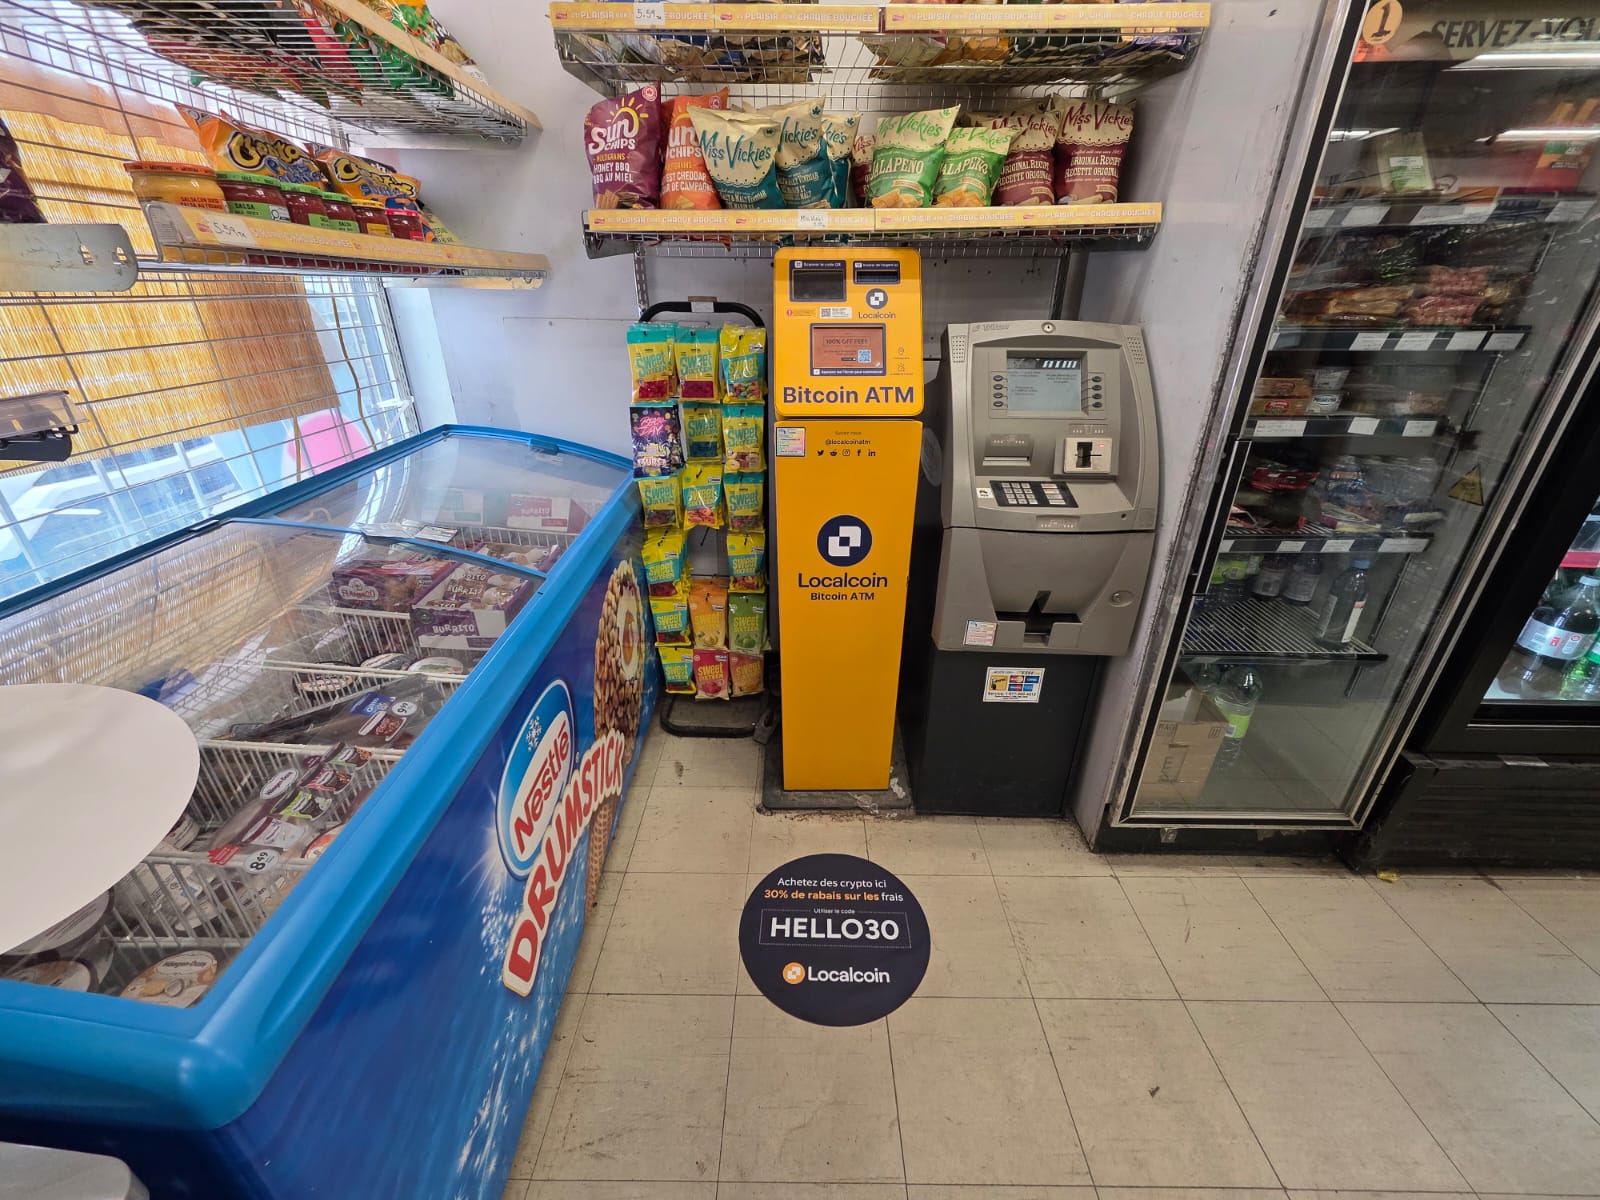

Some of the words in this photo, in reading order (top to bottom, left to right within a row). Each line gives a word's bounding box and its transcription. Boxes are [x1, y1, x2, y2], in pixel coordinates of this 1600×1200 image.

[1371, 3, 1391, 37] 1
[1062, 102, 1092, 137] Miss
[604, 138, 636, 151] CHIPS
[700, 130, 725, 168] Miss
[725, 135, 772, 169] Vickie's
[670, 147, 702, 159] CHIPS
[594, 163, 614, 172] HONEY
[615, 162, 630, 172] BBQ
[614, 173, 634, 183] MIEL
[783, 386, 859, 404] Bitcoin
[865, 386, 914, 403] ATM
[797, 572, 888, 588] Localcoin
[810, 591, 848, 601] Bitcoin
[850, 592, 875, 601] ATM
[432, 624, 475, 634] BURRITO
[514, 720, 570, 855] Nestlé
[507, 734, 625, 983] DRUMSTICK
[777, 877, 818, 887] Achetez
[820, 878, 838, 888] des
[840, 879, 873, 890] crypto
[875, 879, 887, 889] ici
[764, 889, 789, 899] 30%
[791, 889, 806, 899] de
[808, 890, 842, 901] rabais
[844, 892, 861, 901] sur
[863, 892, 880, 901] les
[881, 892, 904, 902] frais
[770, 916, 900, 940] HELLO30
[807, 966, 891, 983] Localcoin
